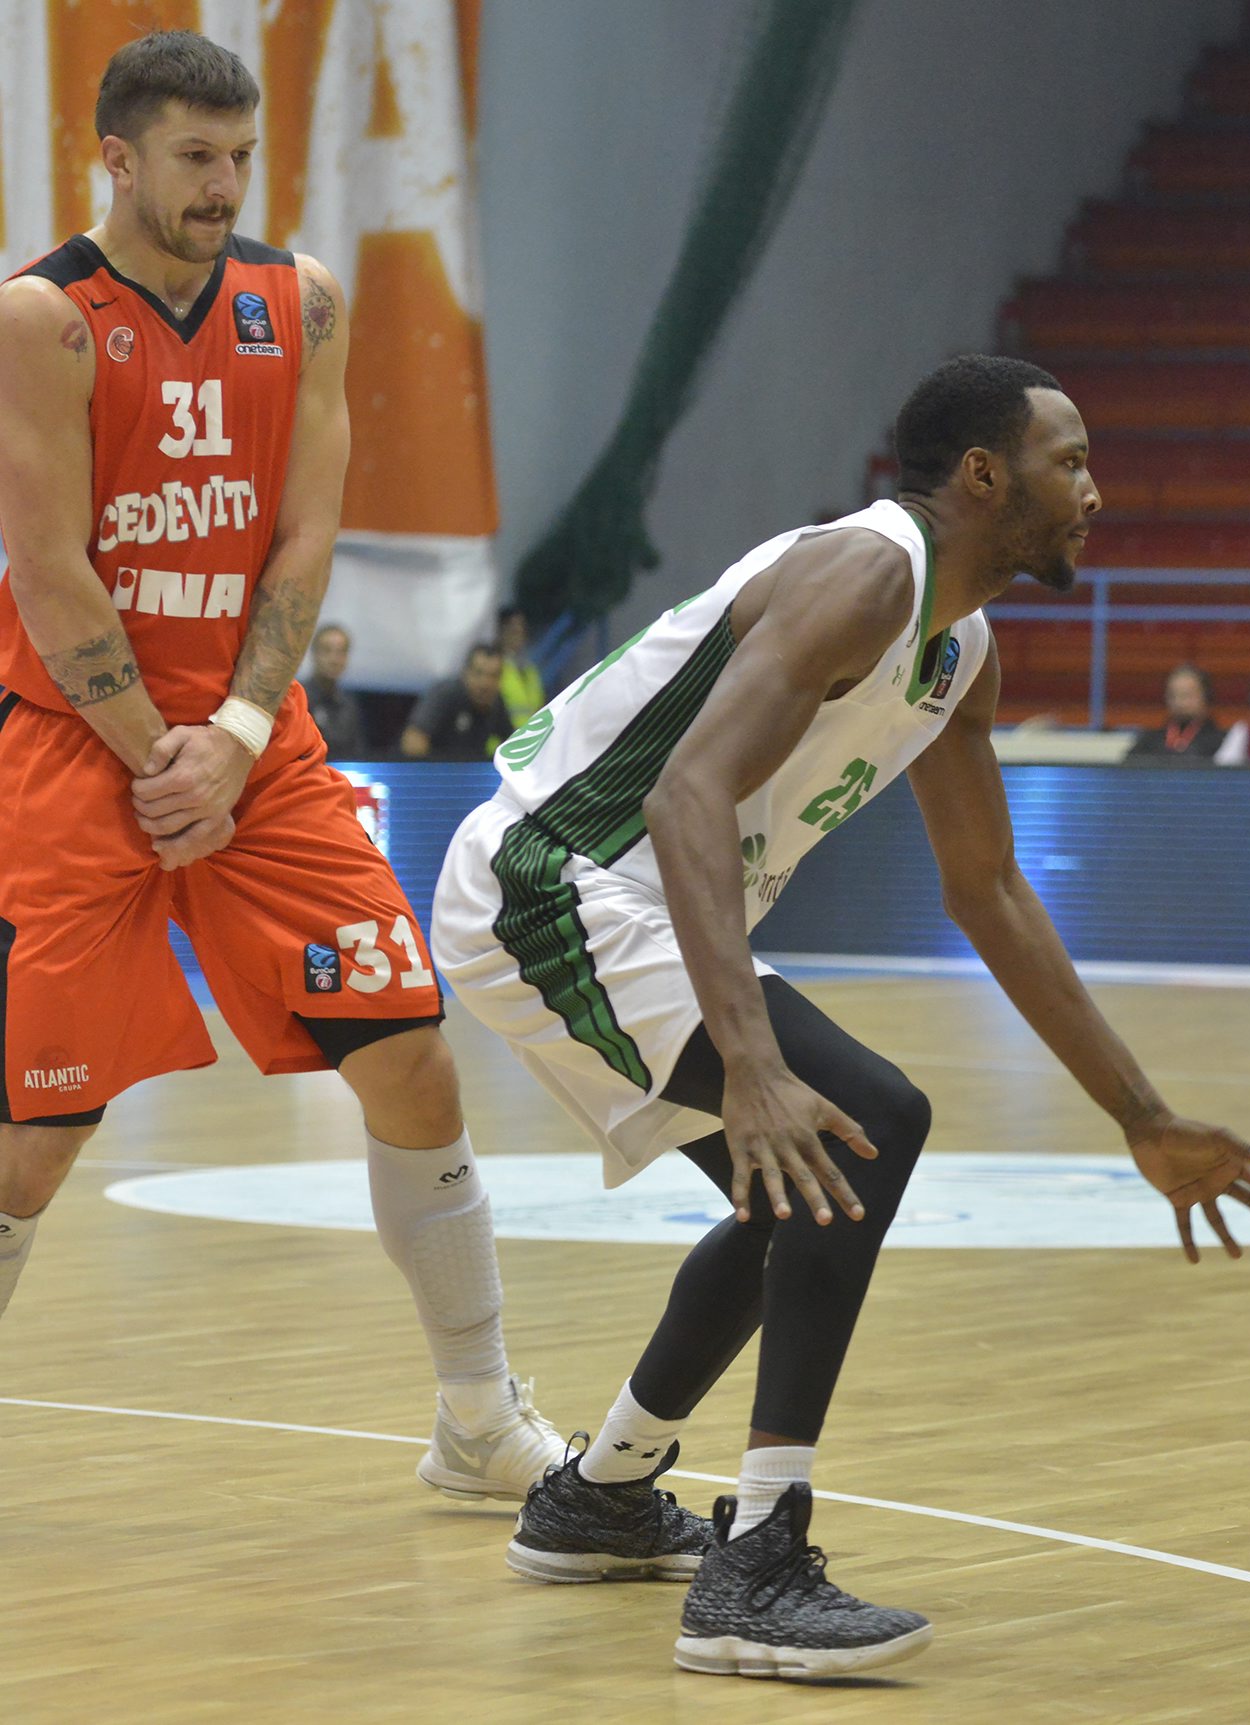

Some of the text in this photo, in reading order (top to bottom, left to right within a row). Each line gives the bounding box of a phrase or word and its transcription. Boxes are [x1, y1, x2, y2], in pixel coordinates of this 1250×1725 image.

[237, 344, 283, 357] oneteam
[158, 379, 232, 459] 31
[335, 915, 435, 994] 31
[24, 1063, 90, 1089] ATLANTIC
